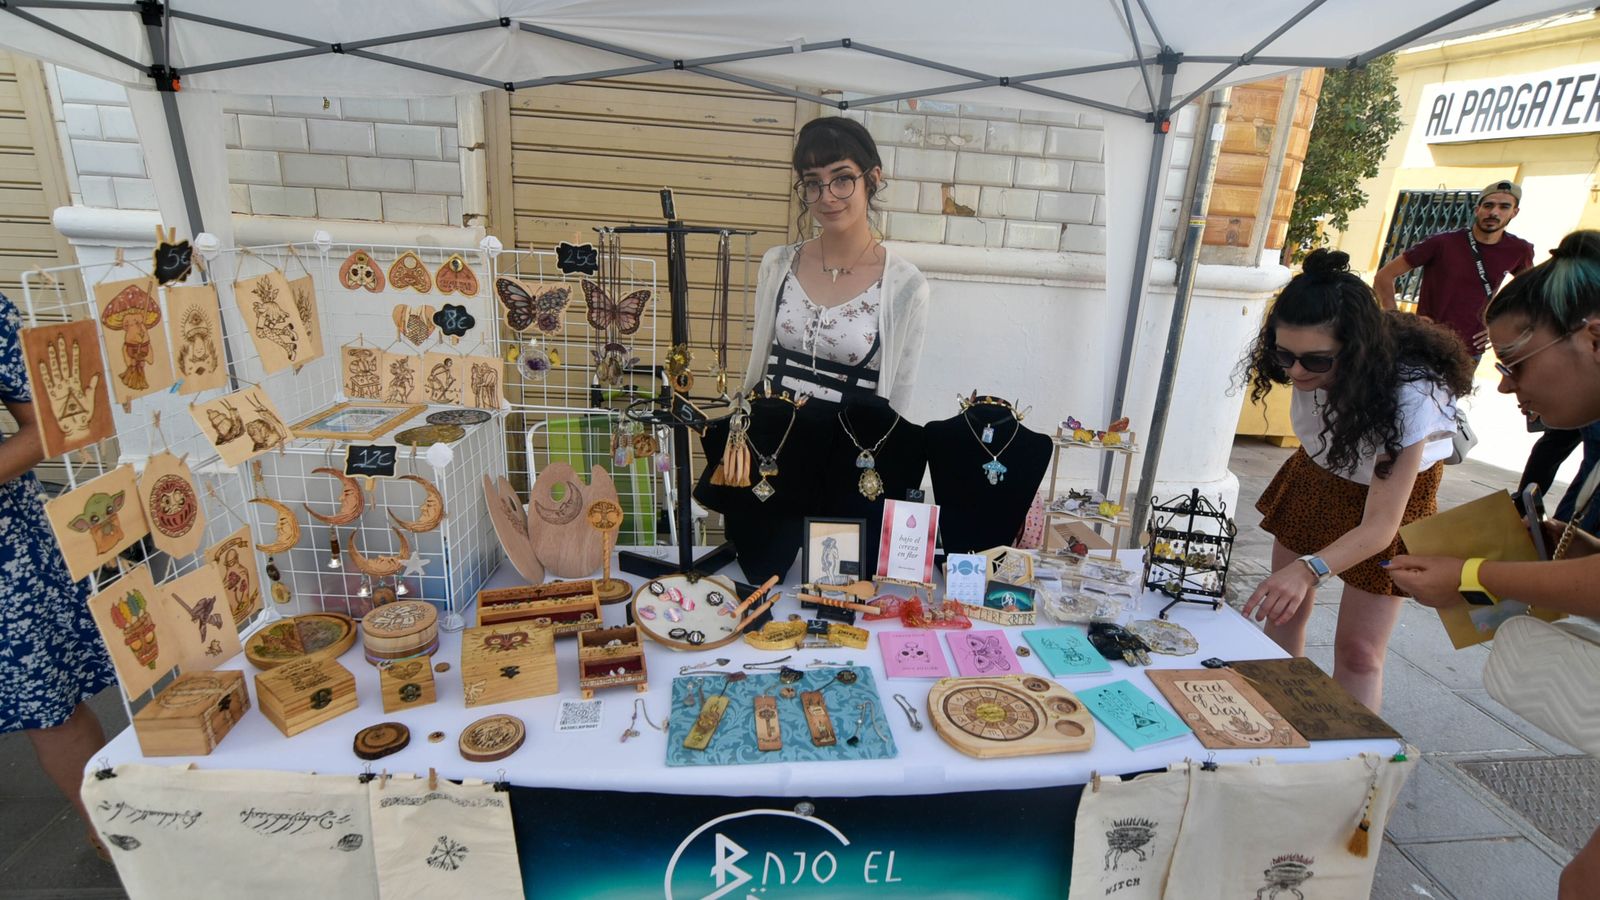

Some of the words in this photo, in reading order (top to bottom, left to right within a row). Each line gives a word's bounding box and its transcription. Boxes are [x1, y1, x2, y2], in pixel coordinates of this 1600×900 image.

[445, 310, 468, 329] 8€
[352, 449, 393, 469] 12€
[1192, 693, 1208, 709] of
[864, 850, 902, 884] EL
